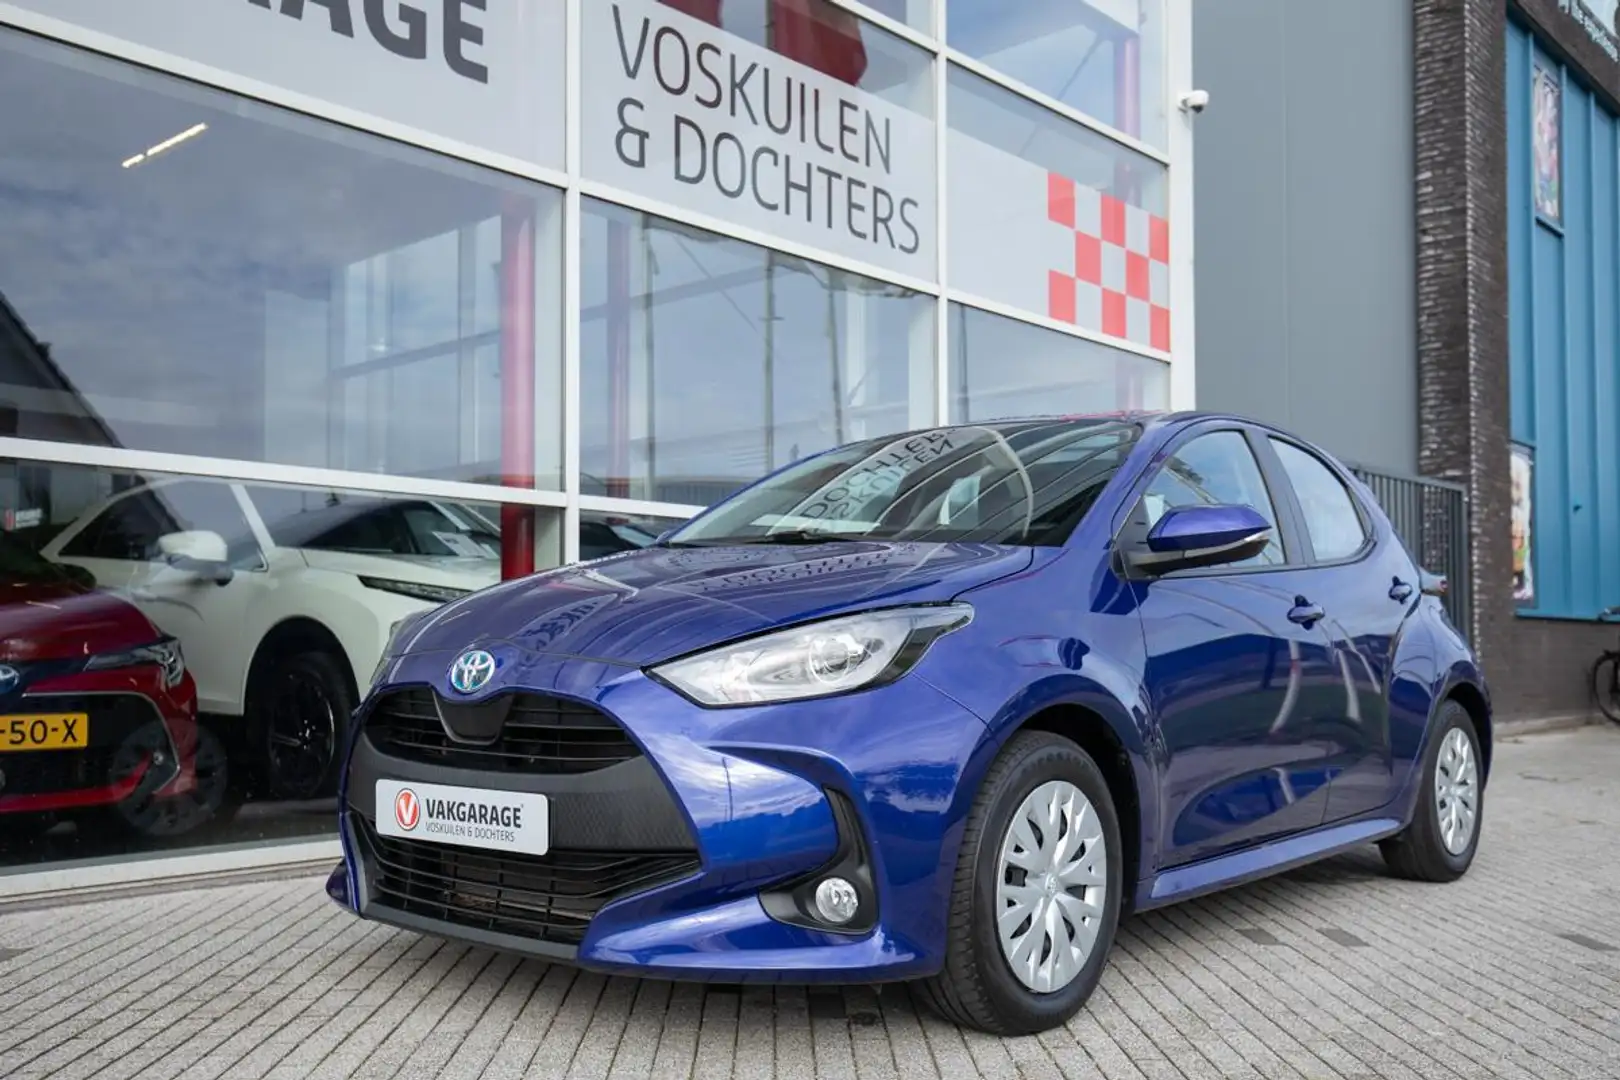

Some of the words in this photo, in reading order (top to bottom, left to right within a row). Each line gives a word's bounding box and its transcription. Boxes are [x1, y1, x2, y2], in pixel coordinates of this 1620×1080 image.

[247, 0, 488, 84] GE
[612, 4, 890, 174] VOSKUILEN
[615, 97, 649, 169] &
[674, 114, 920, 254] DOCHTERS
[426, 798, 522, 828] VAKGARAGE
[426, 822, 466, 836] VOSKUILEN
[475, 828, 515, 842] DOCHTERS
